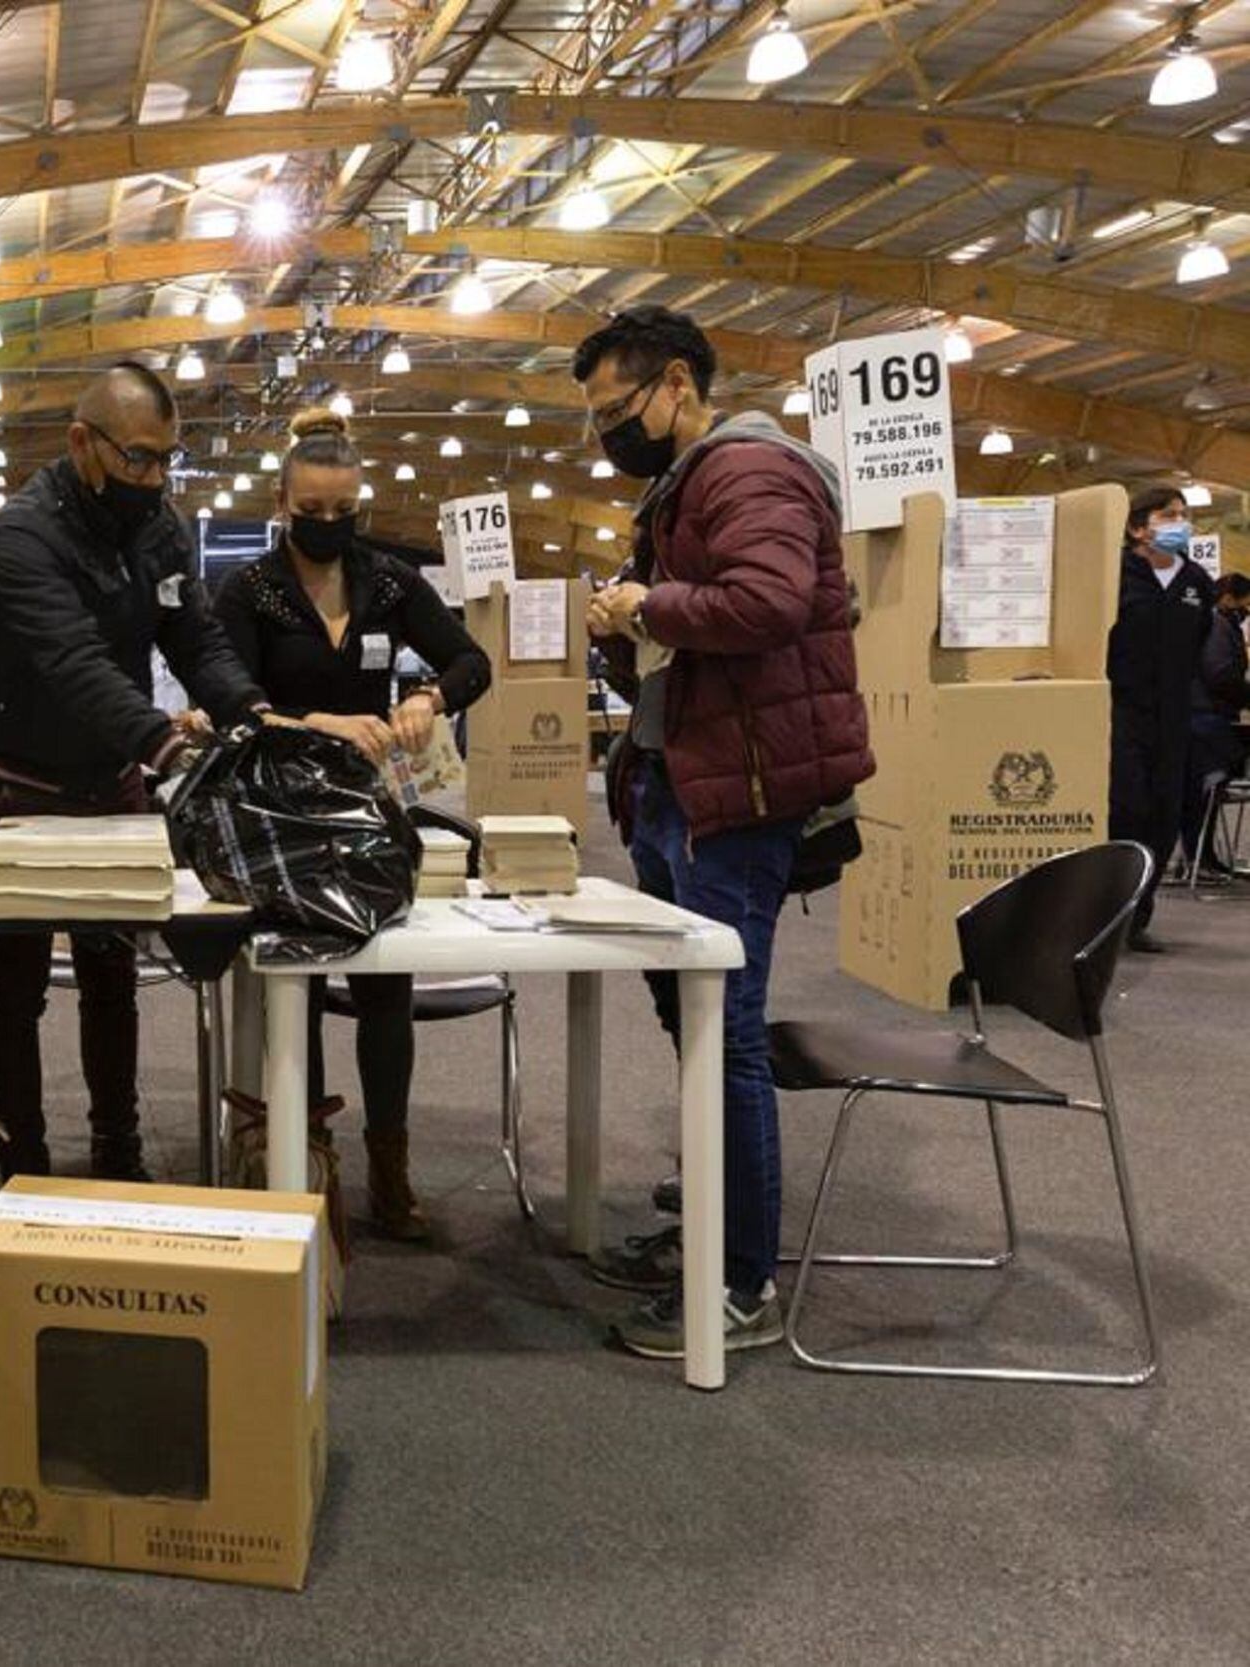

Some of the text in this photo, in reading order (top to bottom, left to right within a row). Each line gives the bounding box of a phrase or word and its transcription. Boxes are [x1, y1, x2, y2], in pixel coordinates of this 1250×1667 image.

[809, 367, 838, 419] 169
[848, 351, 941, 406] 169
[852, 421, 942, 445] 79.588.196
[856, 456, 944, 480] 79.592.491
[459, 503, 507, 533] 176
[949, 810, 1094, 827] REGISTRADURÍA
[34, 1282, 208, 1316] CONSULTAS
